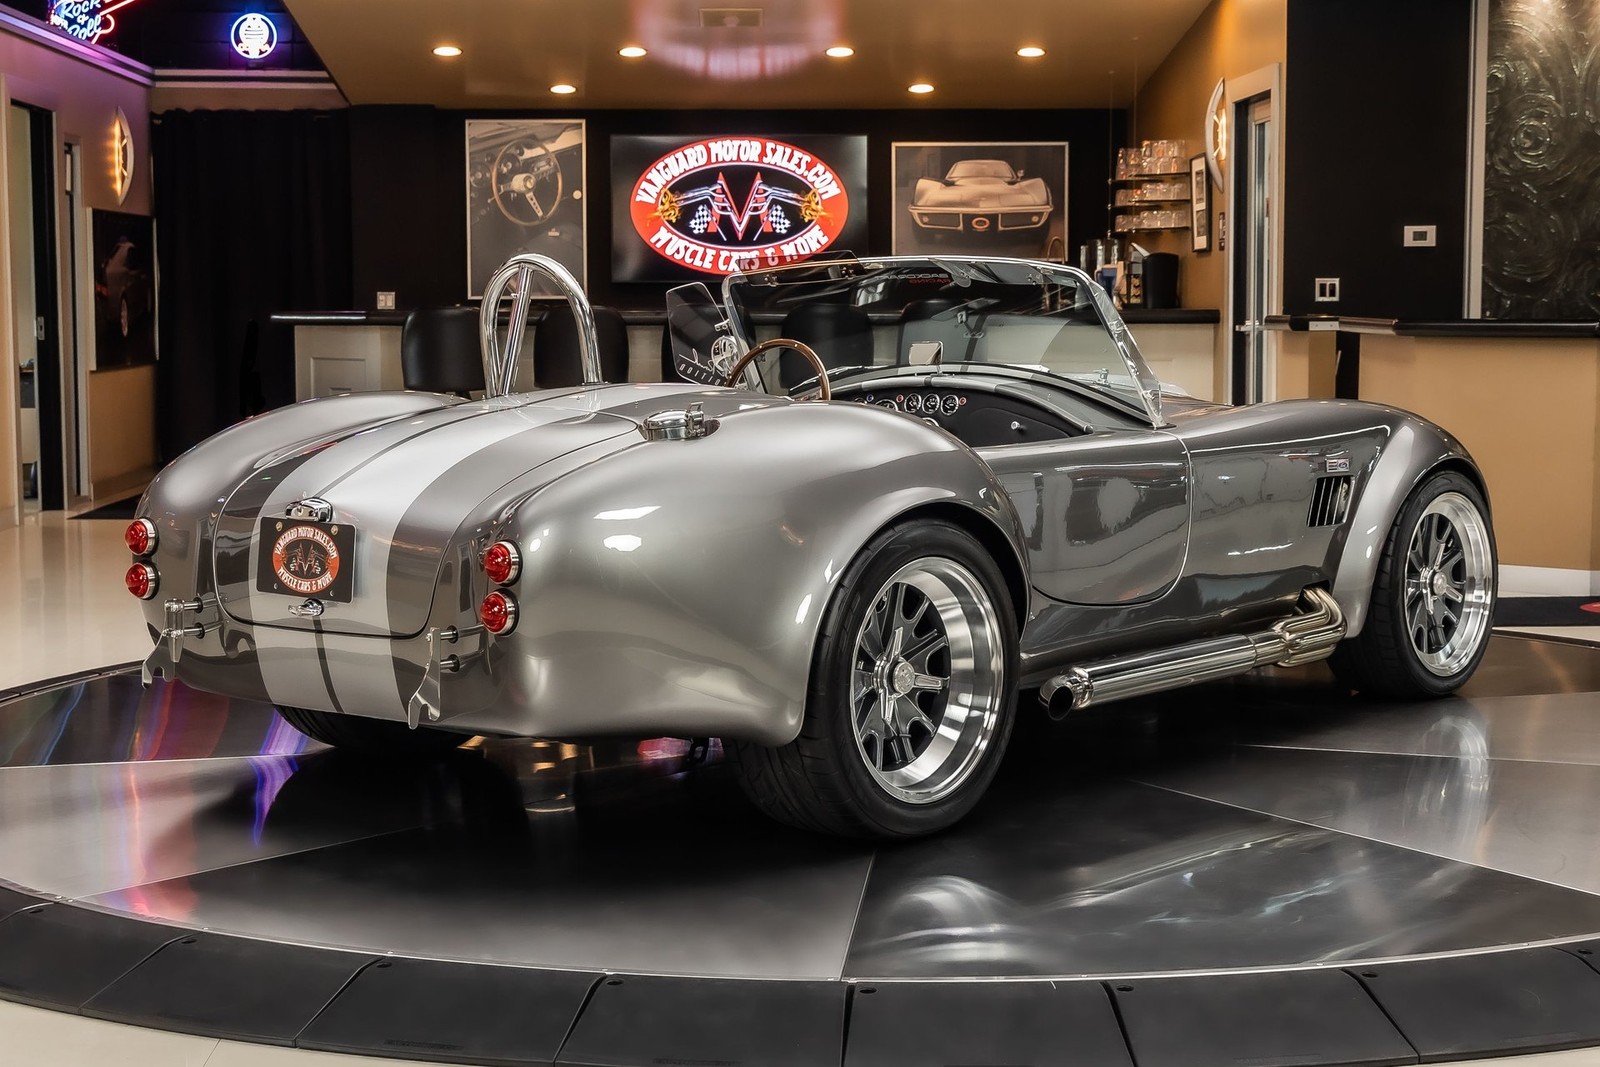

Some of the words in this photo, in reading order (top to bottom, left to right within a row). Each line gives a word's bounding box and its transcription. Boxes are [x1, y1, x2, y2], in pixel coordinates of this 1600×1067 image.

[636, 144, 709, 203] VANGUARD
[708, 139, 762, 163] MOTOR
[763, 141, 841, 199] SALES.COM
[650, 226, 716, 269] MUSCLE
[718, 250, 759, 272] CARS
[765, 248, 779, 266] &
[780, 224, 829, 262] MORE
[274, 528, 298, 555] VANGUARD
[298, 526, 314, 538] MOTOR
[277, 566, 297, 589] MUSCLE
[297, 578, 311, 592] CARS
[317, 571, 333, 589] MORE
